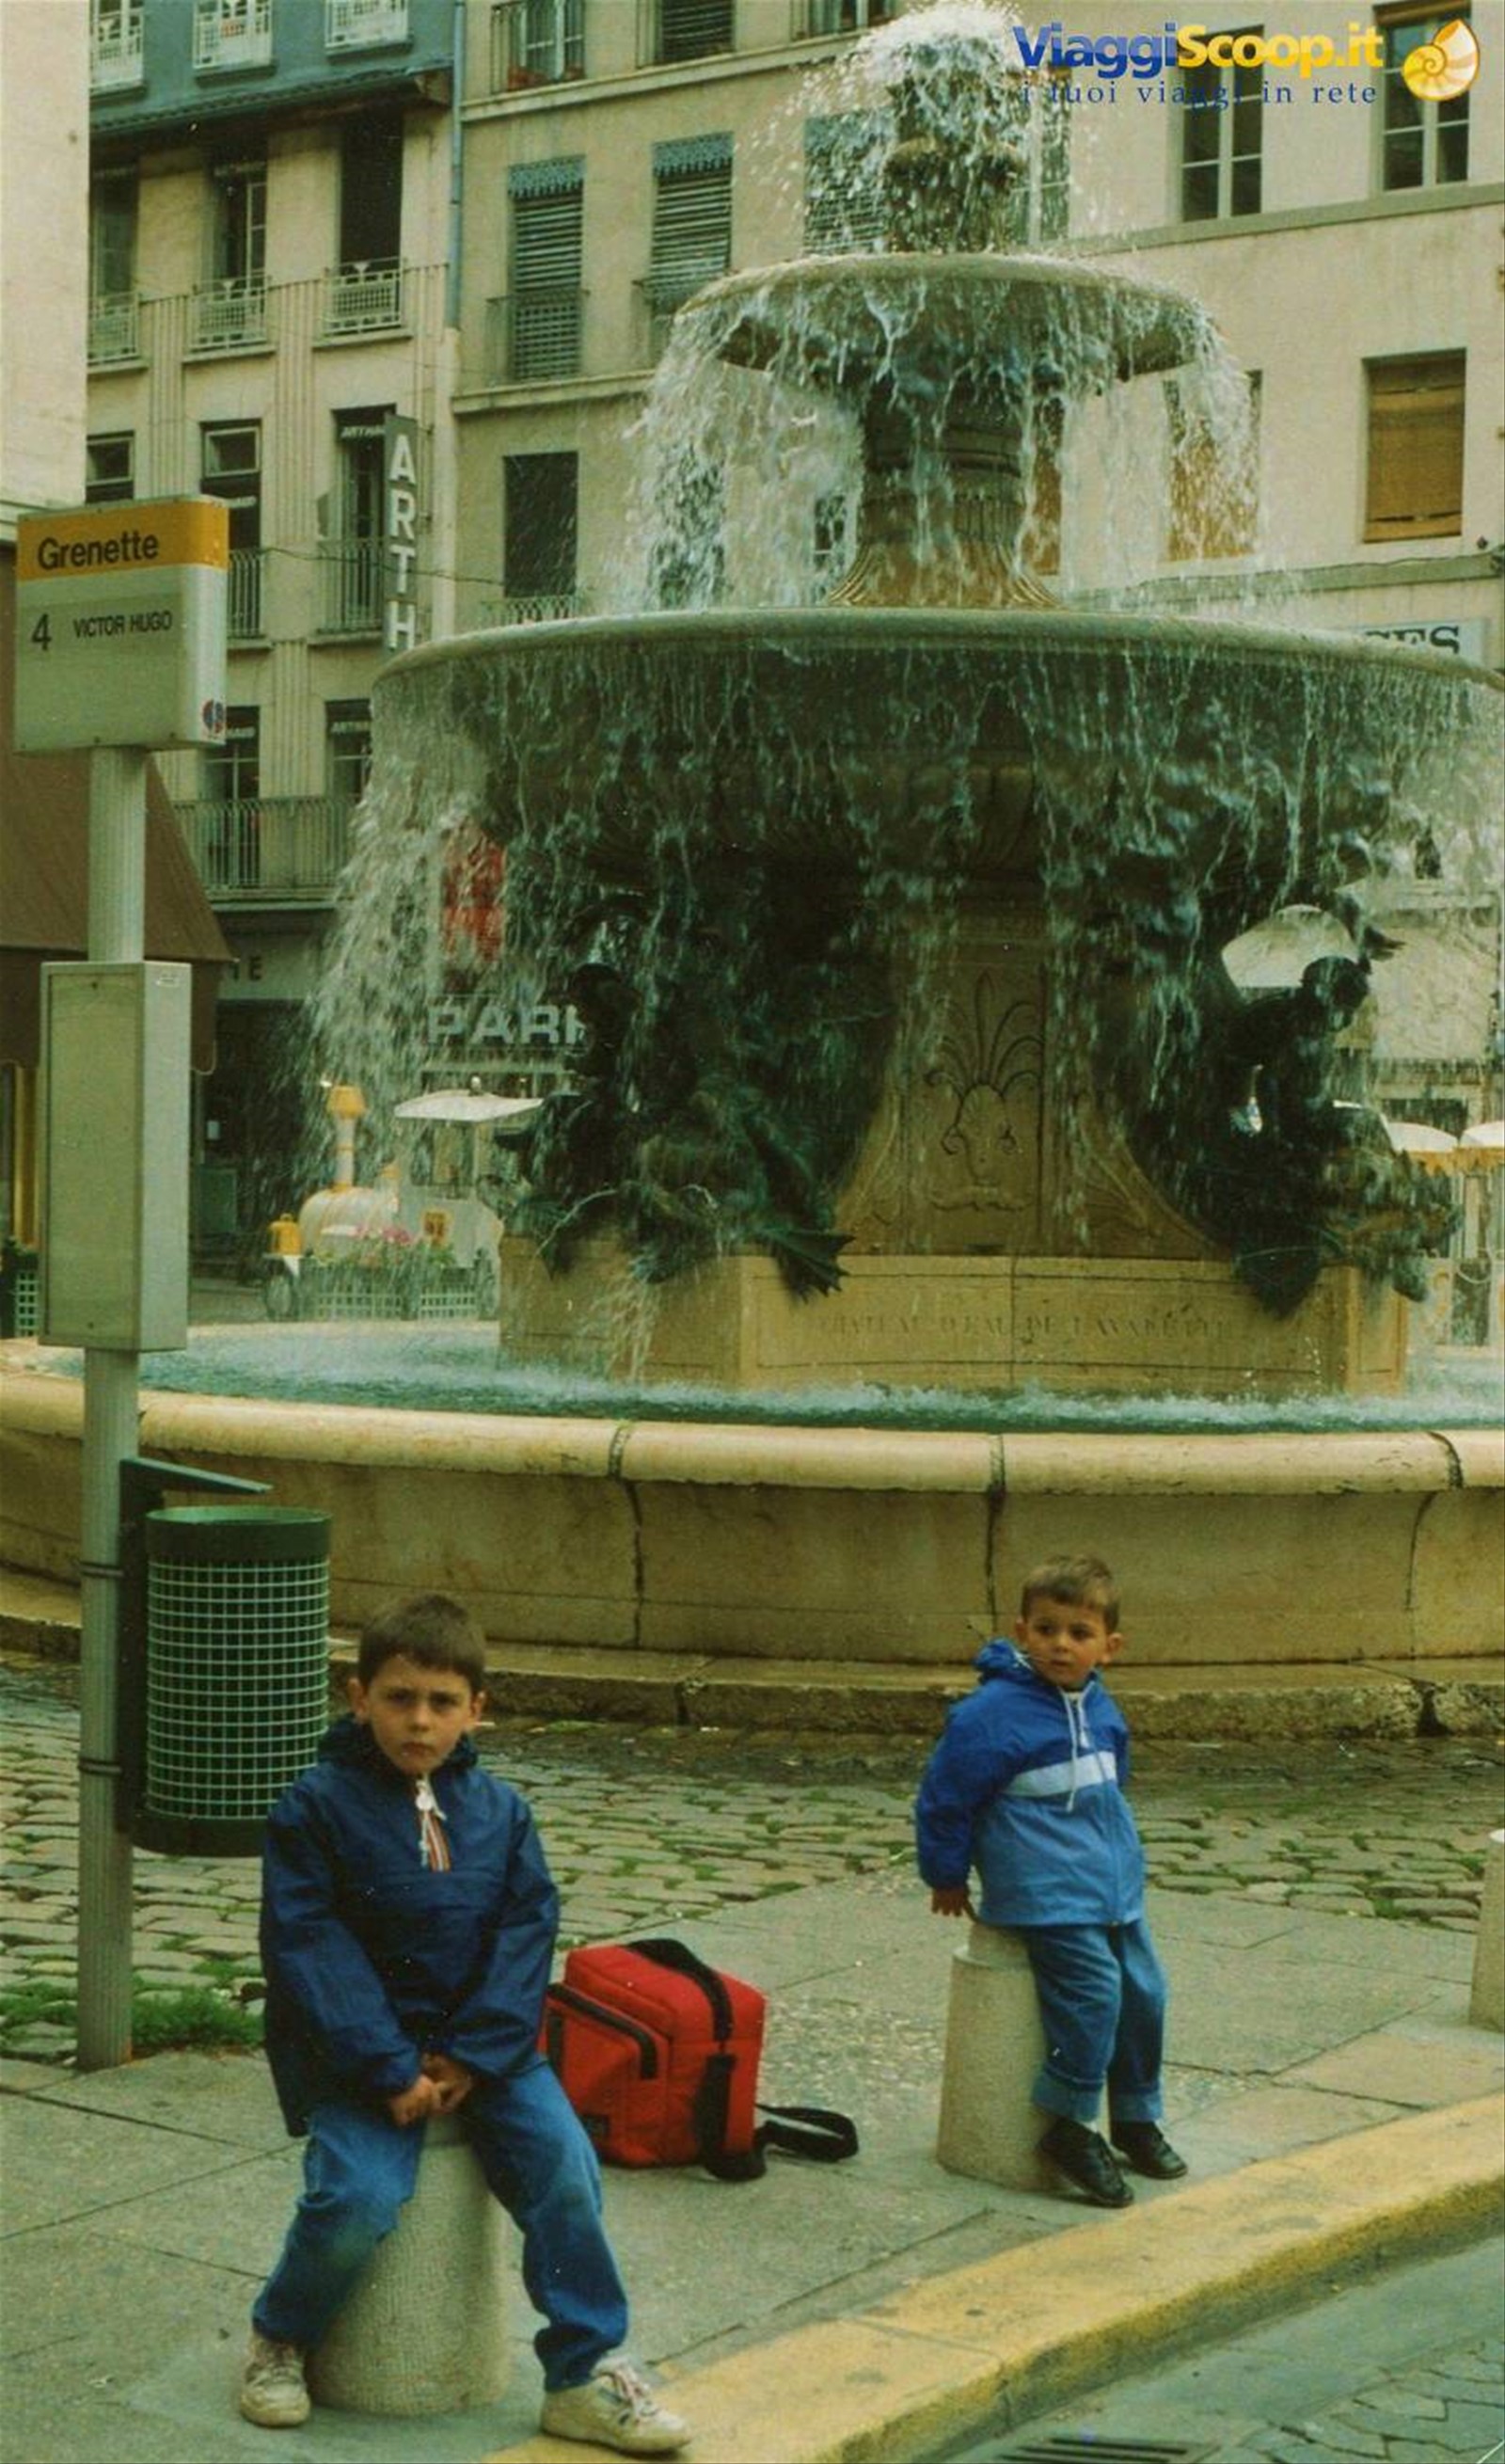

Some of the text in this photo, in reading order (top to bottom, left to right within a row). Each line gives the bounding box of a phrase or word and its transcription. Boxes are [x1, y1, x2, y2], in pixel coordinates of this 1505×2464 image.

[38, 530, 160, 571] Grenette
[31, 609, 174, 652] 4 VICTOR HUGO
